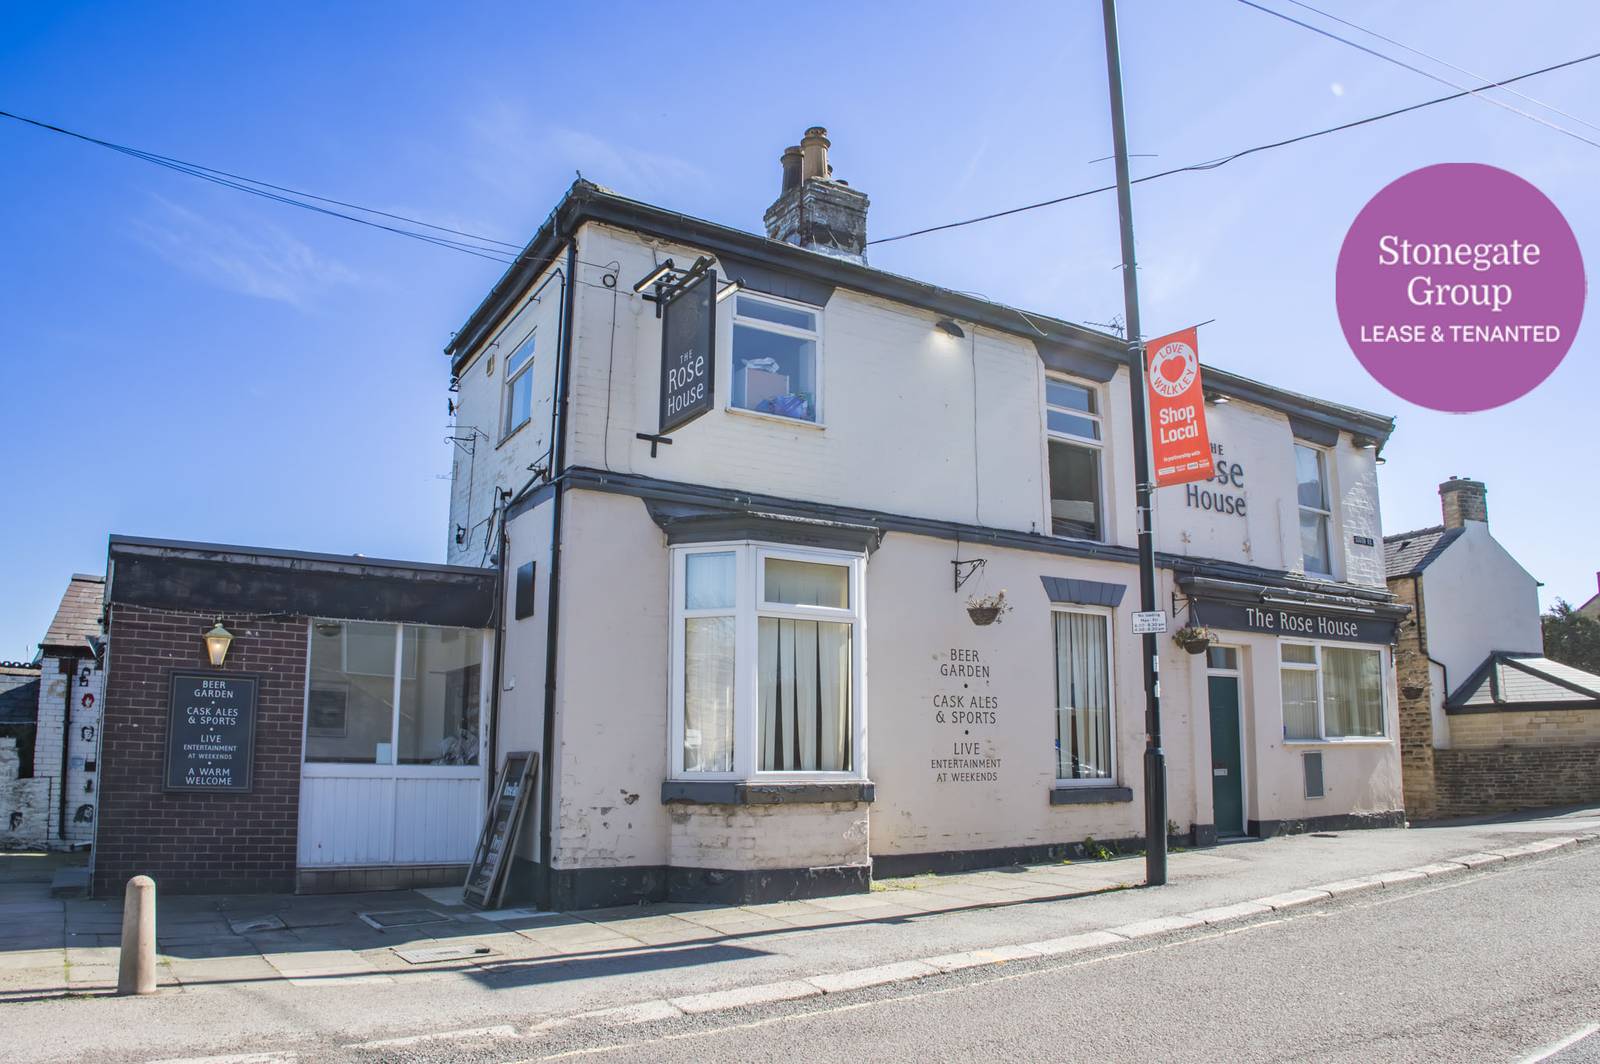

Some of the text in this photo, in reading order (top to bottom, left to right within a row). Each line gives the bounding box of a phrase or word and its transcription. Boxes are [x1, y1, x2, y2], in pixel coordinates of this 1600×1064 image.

[680, 350, 694, 364] THE
[1159, 343, 1184, 360] LOVE
[668, 356, 704, 394] Rose
[1154, 368, 1194, 395] WALKLEY
[667, 383, 704, 417] House
[1160, 405, 1196, 425] Shop
[1160, 421, 1199, 444] Local
[1210, 442, 1224, 456] HE
[1186, 484, 1246, 517] House
[1246, 608, 1358, 637] The Rose House
[950, 648, 980, 662] BEER
[940, 664, 990, 678] GARDEN
[202, 680, 226, 689] BEER
[194, 689, 234, 698] GARDEN
[933, 694, 998, 709] CASK ALES
[186, 706, 238, 716] CASK ALES
[936, 710, 997, 724] & SPORTS
[188, 716, 236, 725] & SPORTS
[954, 742, 980, 755] LIVE
[931, 759, 1001, 768] ENTERTAINMENT
[200, 768, 230, 776] WARM
[936, 772, 998, 782] AT WEEKENDS
[186, 777, 232, 785] WELCOME
